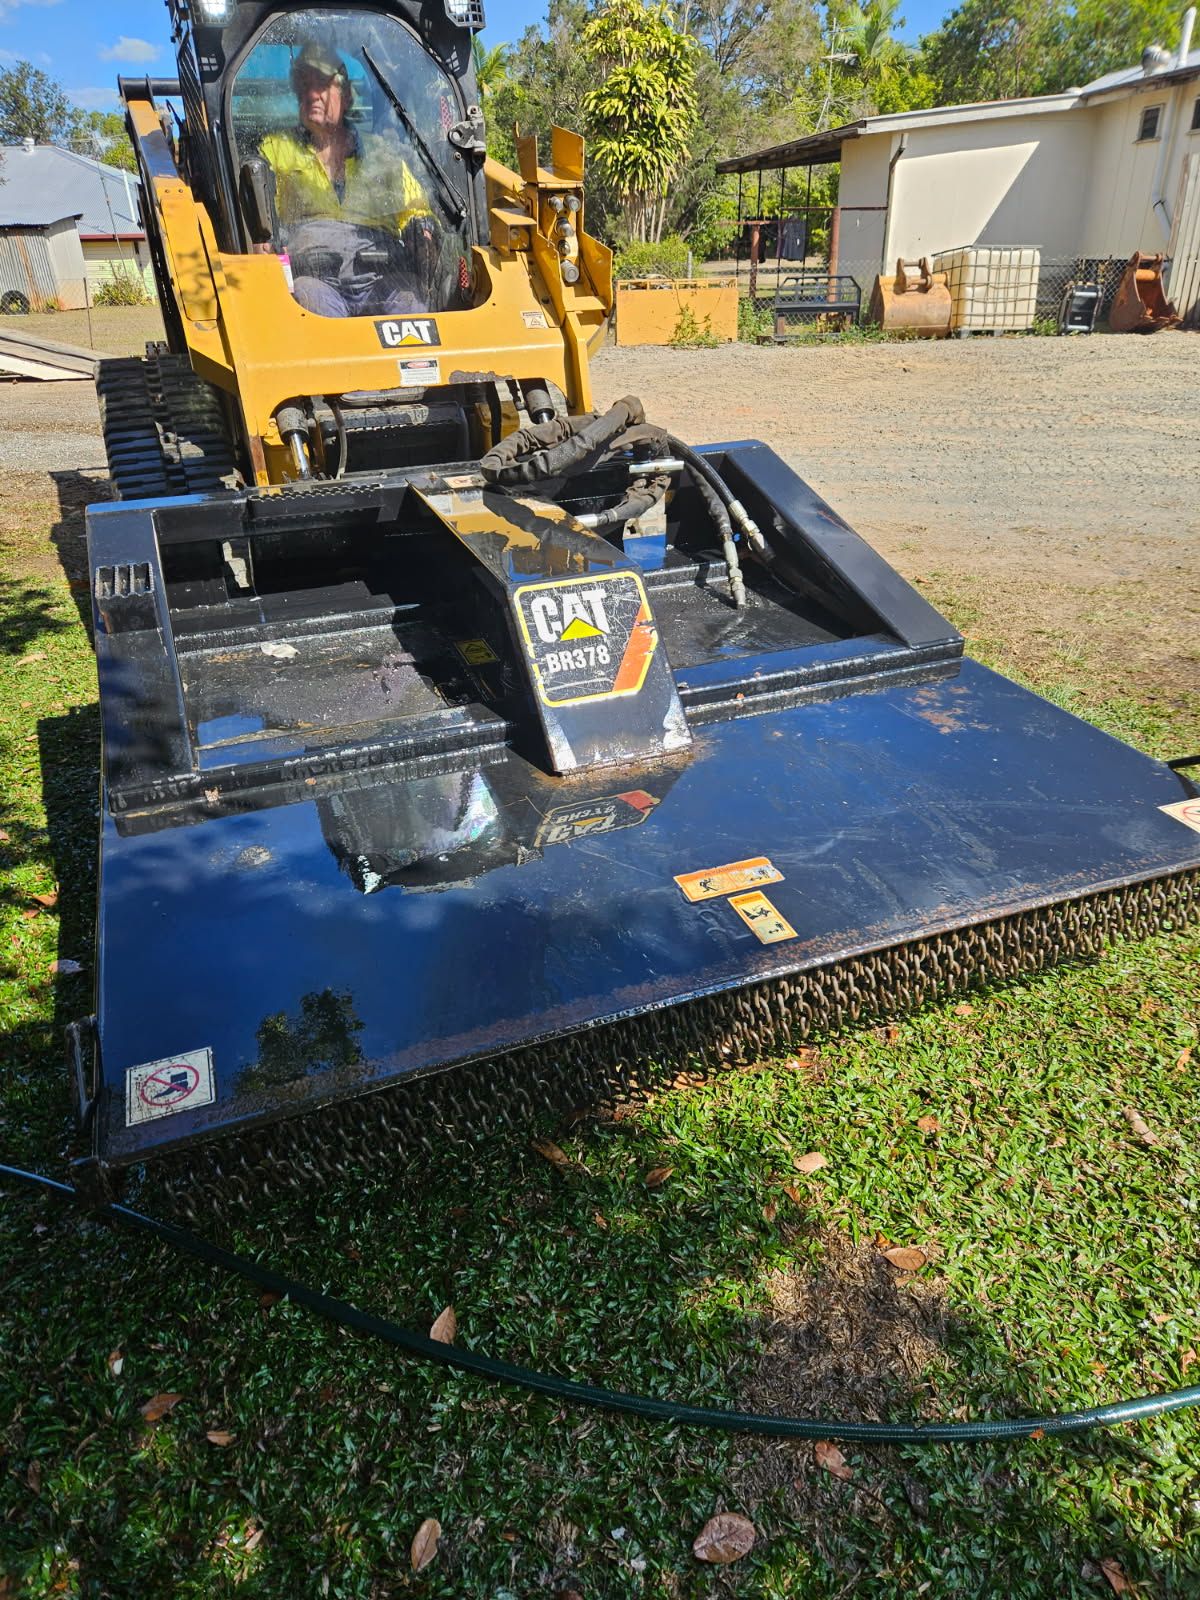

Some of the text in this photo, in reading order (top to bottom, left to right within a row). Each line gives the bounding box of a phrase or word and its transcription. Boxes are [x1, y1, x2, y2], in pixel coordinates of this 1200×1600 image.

[381, 319, 432, 346] CAT
[530, 588, 611, 643] CAT
[545, 644, 611, 674] BR378
